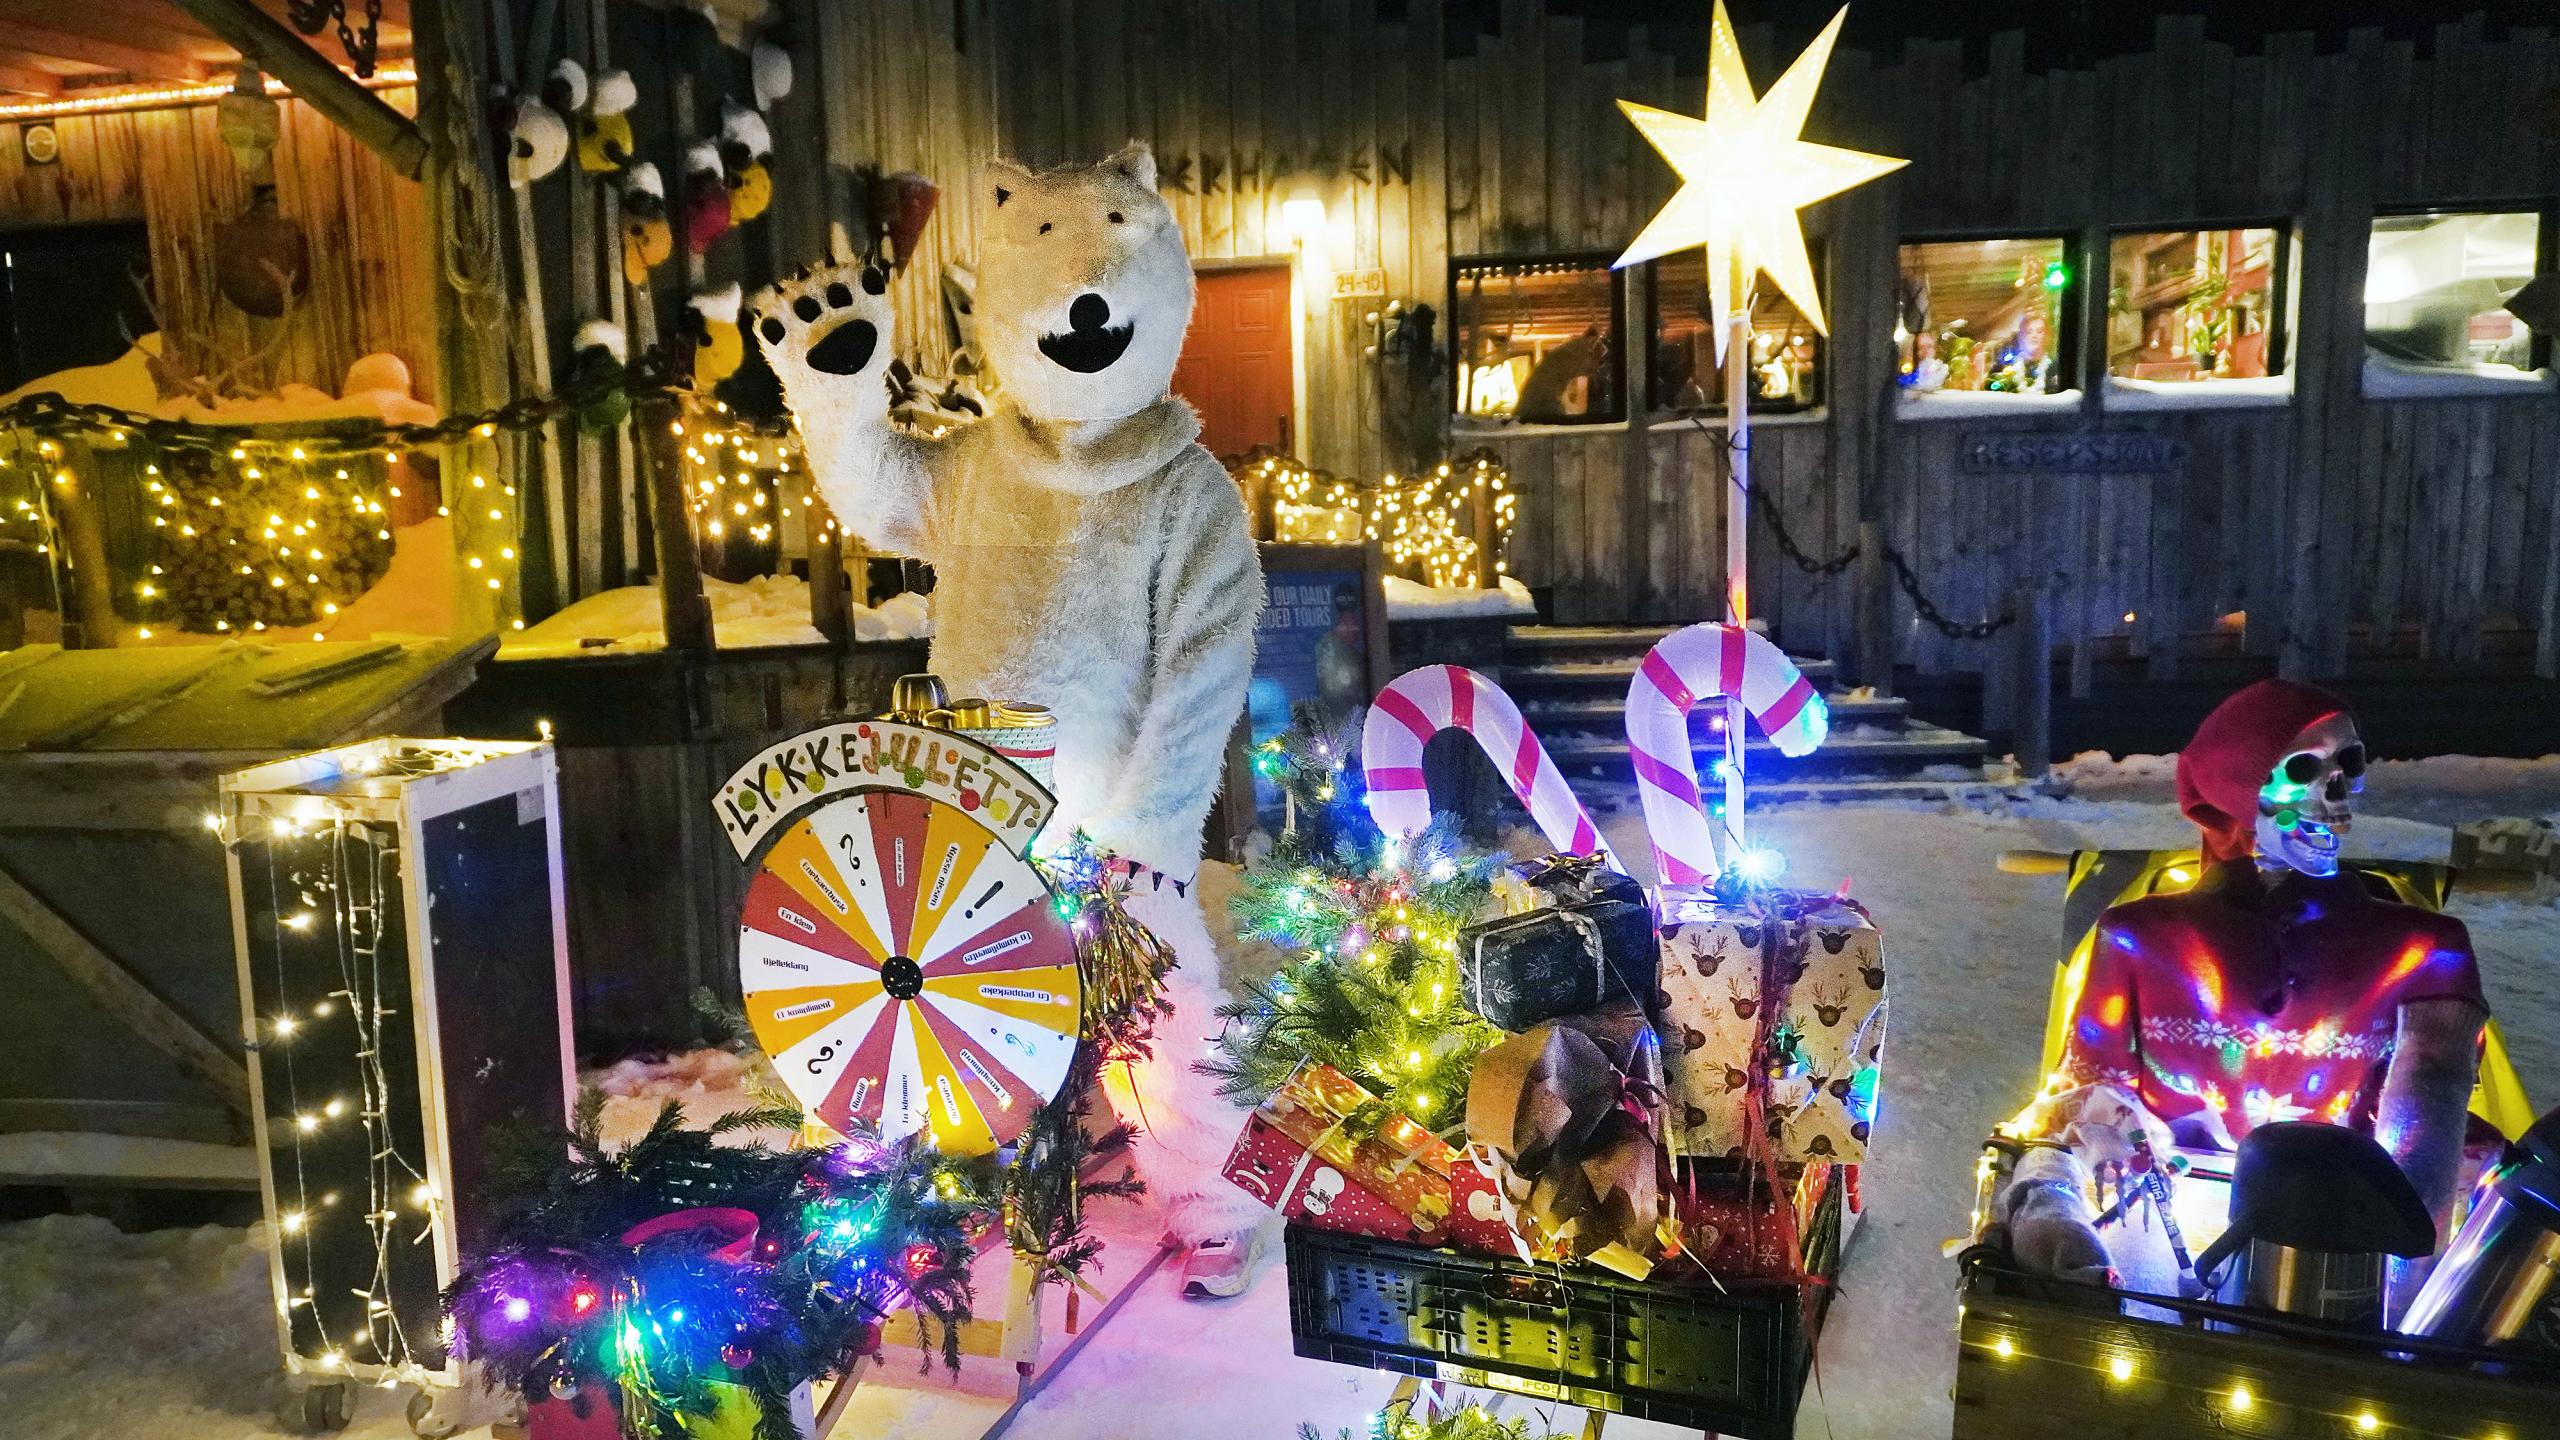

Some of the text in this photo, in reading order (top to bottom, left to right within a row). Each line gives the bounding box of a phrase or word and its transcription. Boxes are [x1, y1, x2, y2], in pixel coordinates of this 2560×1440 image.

[1335, 273, 1382, 294] 24-40
[1272, 584, 1331, 606] OUR DAILY
[1294, 605, 1331, 627] TOURS
[930, 846, 958, 906] Kysse nissen
[780, 908, 815, 932] En klem
[965, 938, 1020, 963] komplimenter
[762, 956, 809, 972] Bjelleklang
[980, 986, 1050, 1002] En pepperkake
[786, 1000, 831, 1018] kompliment
[961, 1050, 1001, 1093] kompliment
[852, 1082, 868, 1110] Rudolf
[1522, 1380, 1551, 1392] IFCO
